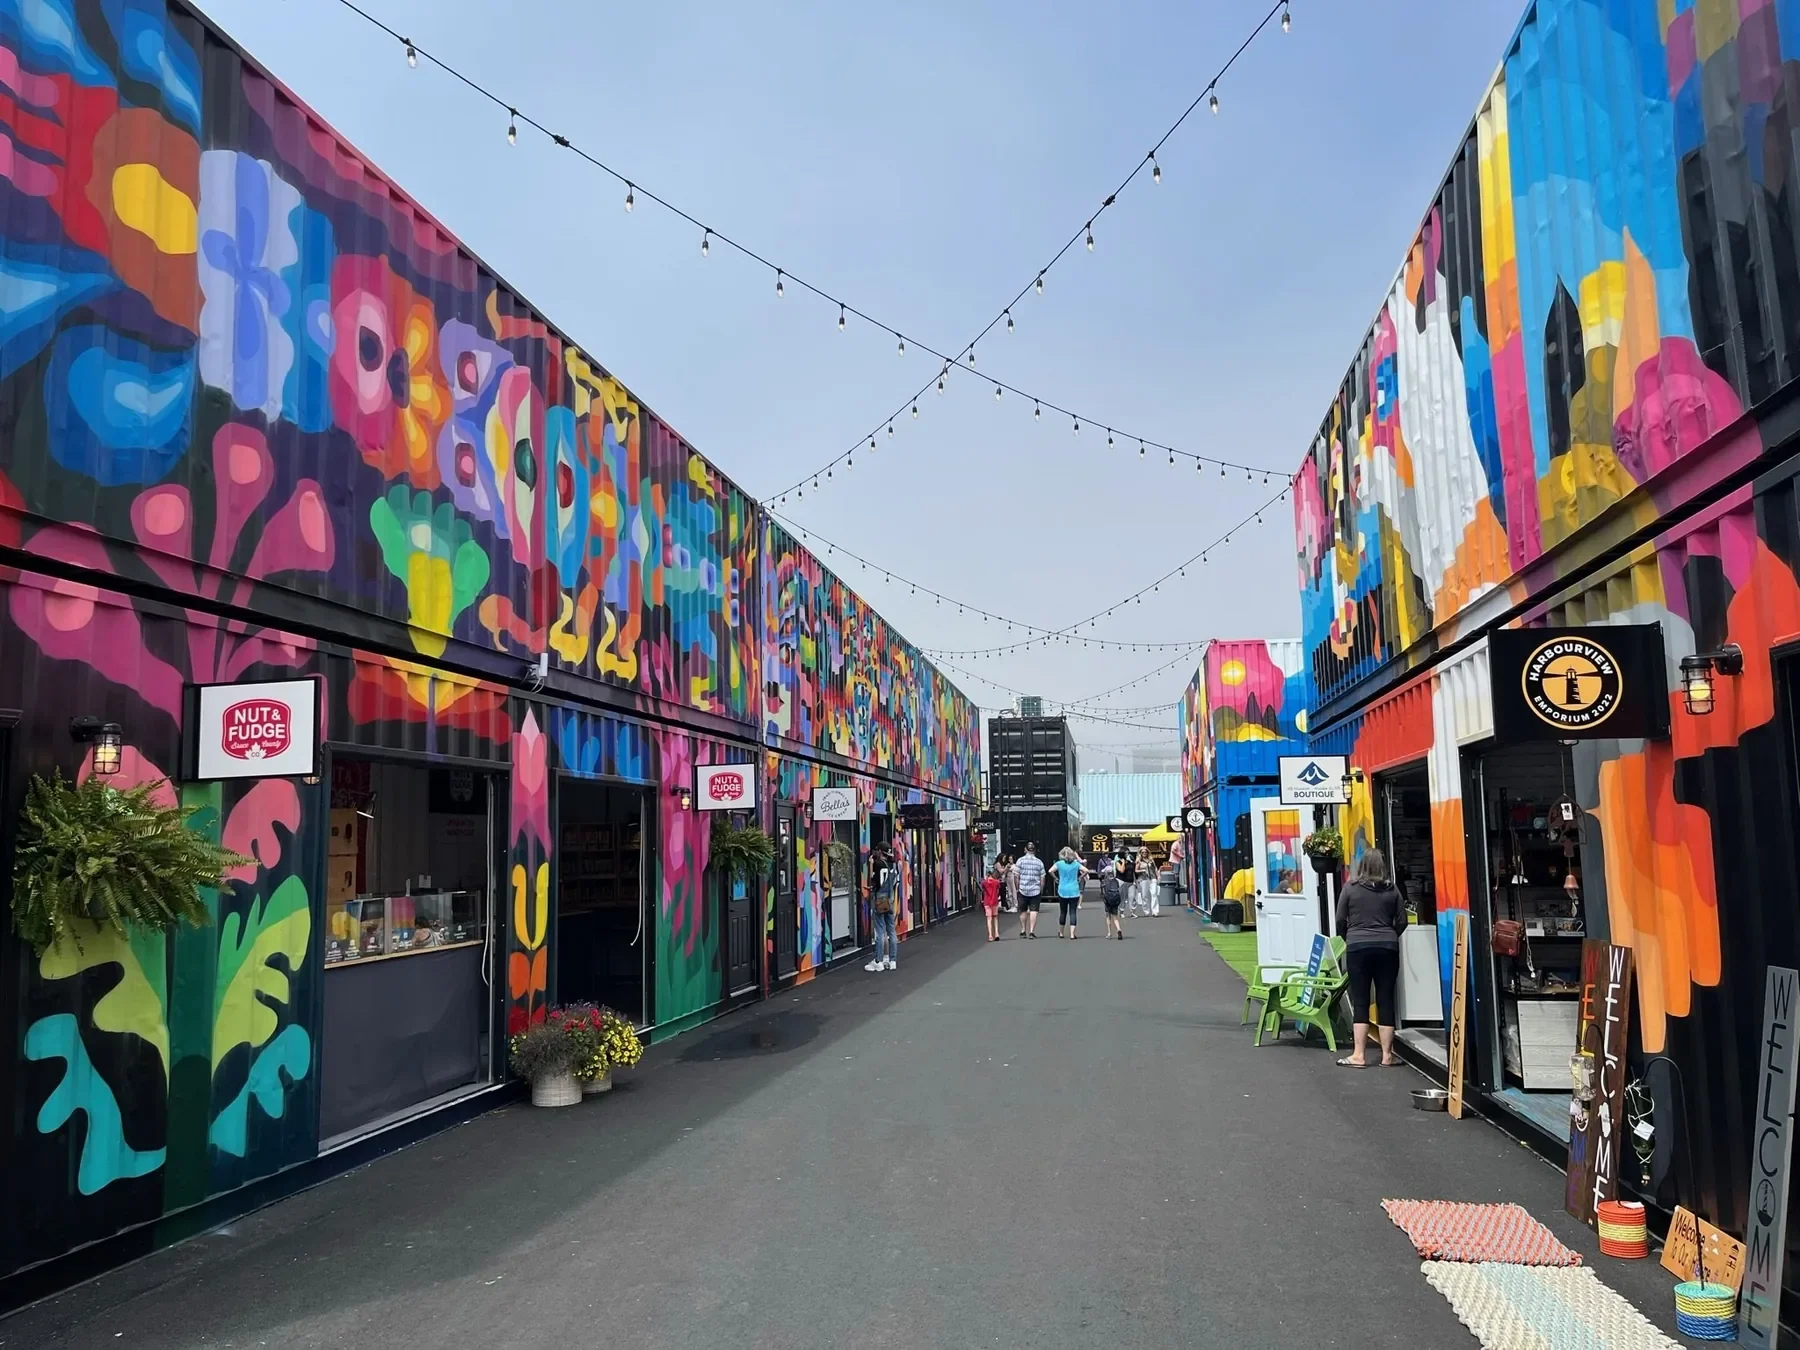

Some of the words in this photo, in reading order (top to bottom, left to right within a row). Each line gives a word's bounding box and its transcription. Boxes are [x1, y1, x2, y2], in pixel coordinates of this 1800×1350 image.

[1529, 643, 1613, 681] HARBOURVIEW
[1534, 695, 1590, 722] EMPORIUM
[1591, 693, 1613, 717] 2022
[228, 723, 286, 741] FUDGE
[711, 784, 741, 794] FUDGE
[1093, 842, 1109, 852] EL
[1450, 918, 1465, 1101] WELCOME
[1746, 972, 1793, 1339] WELCOME
